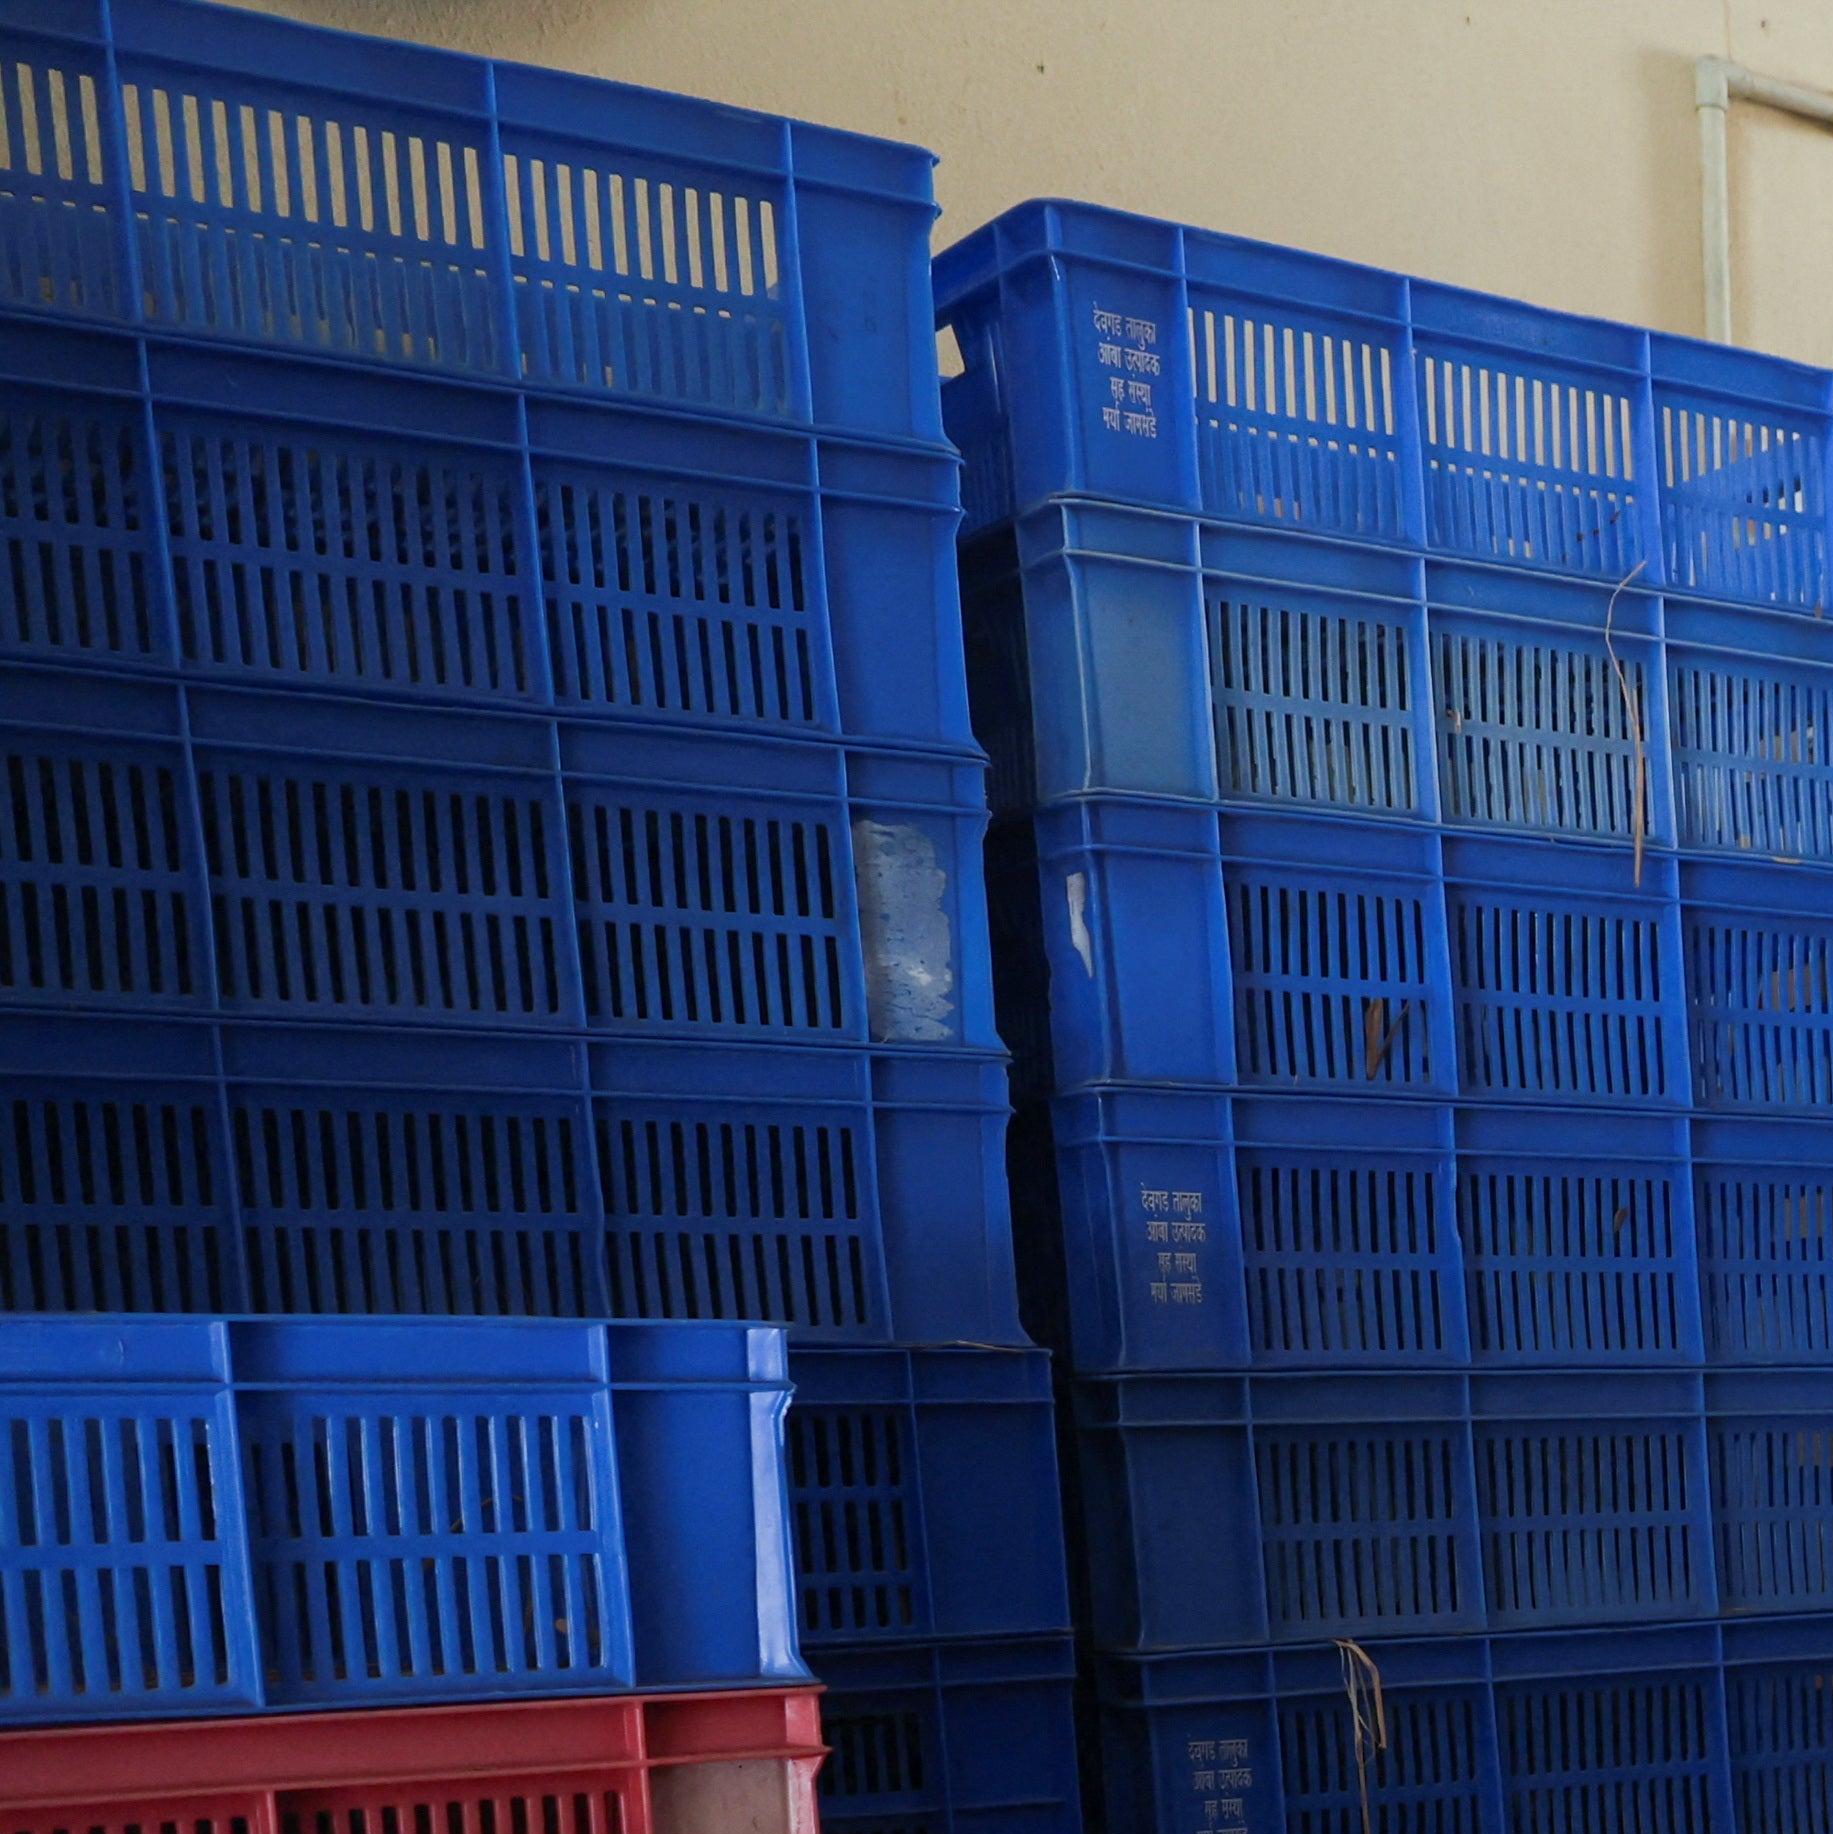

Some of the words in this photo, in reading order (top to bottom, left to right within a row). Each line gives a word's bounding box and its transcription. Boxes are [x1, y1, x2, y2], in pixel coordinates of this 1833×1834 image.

[1093, 300, 1122, 337] देवगड
[1125, 317, 1156, 351] तालुका
[1110, 376, 1125, 402] सह
[1141, 1182, 1170, 1213] देवगड
[1172, 1191, 1203, 1222] तालुका
